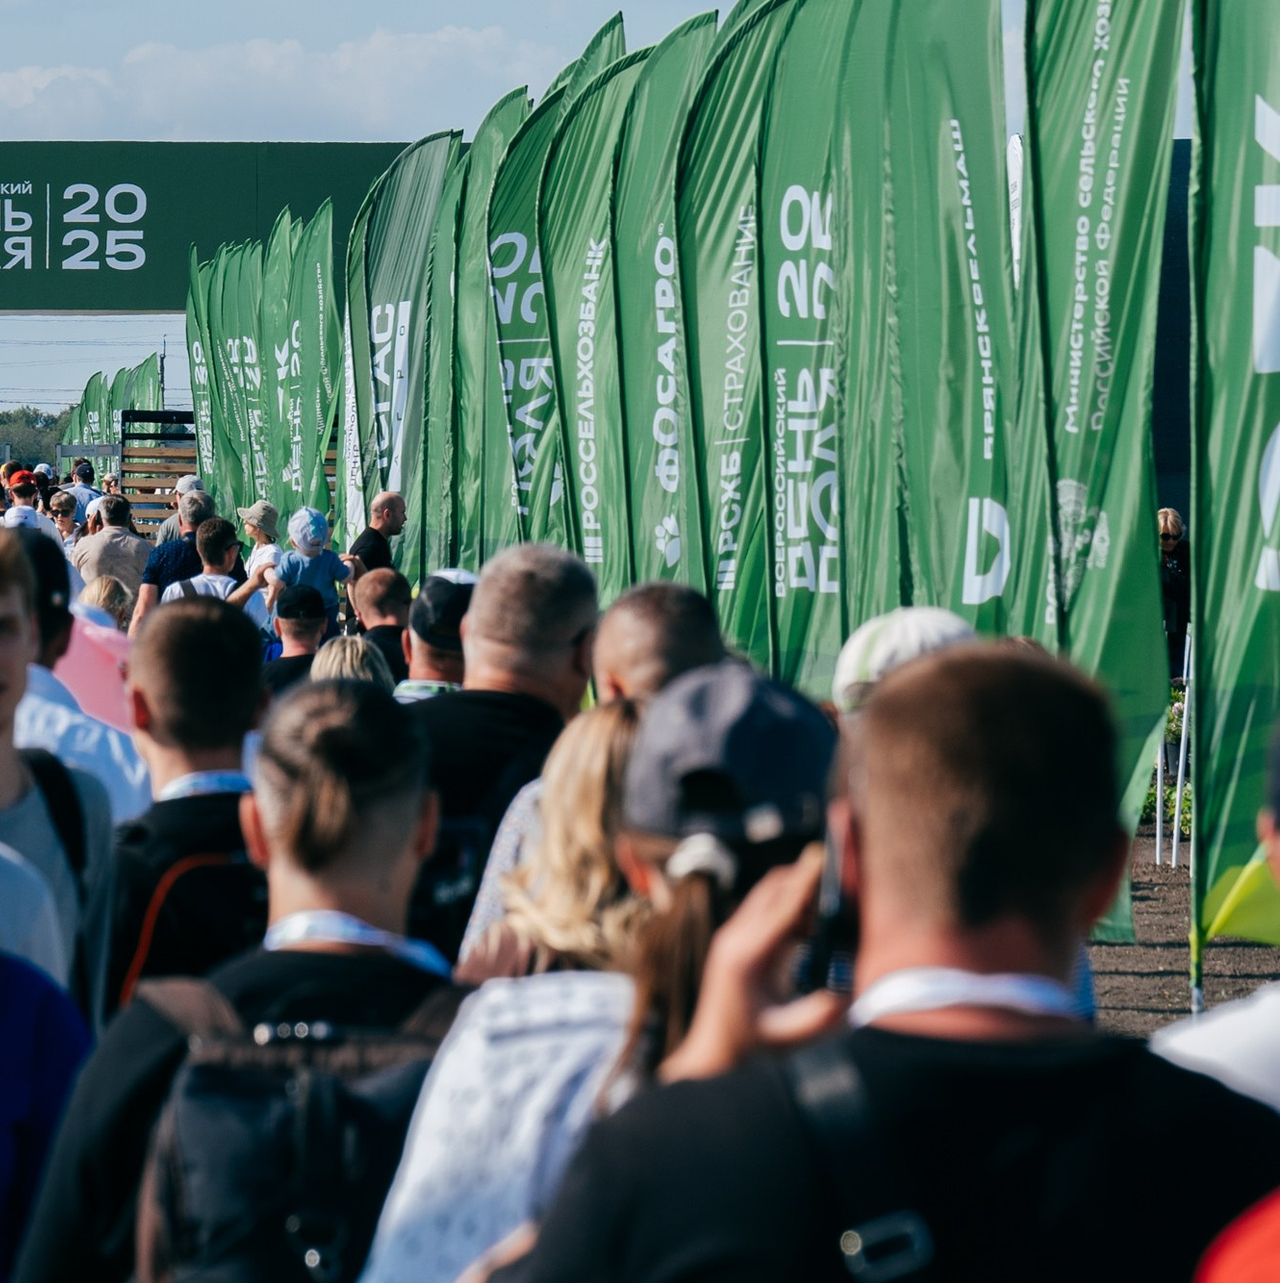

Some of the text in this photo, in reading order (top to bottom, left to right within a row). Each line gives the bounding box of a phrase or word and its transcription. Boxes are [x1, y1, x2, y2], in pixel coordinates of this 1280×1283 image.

[62, 230, 146, 270] 25
[63, 183, 147, 223] 20
[778, 184, 811, 318] 20
[1064, 215, 1089, 433] Министерство
[1079, 58, 1105, 208] сельского
[1095, 77, 1129, 250] Федерации
[576, 238, 606, 530] РОССЕЛЬХОЗБАНК
[718, 205, 756, 560] РСХБ СТРАХОВАНИЕ
[775, 368, 787, 597] ВСЕРОССИЙСКИЙ
[787, 368, 818, 592] ДЕНЬ
